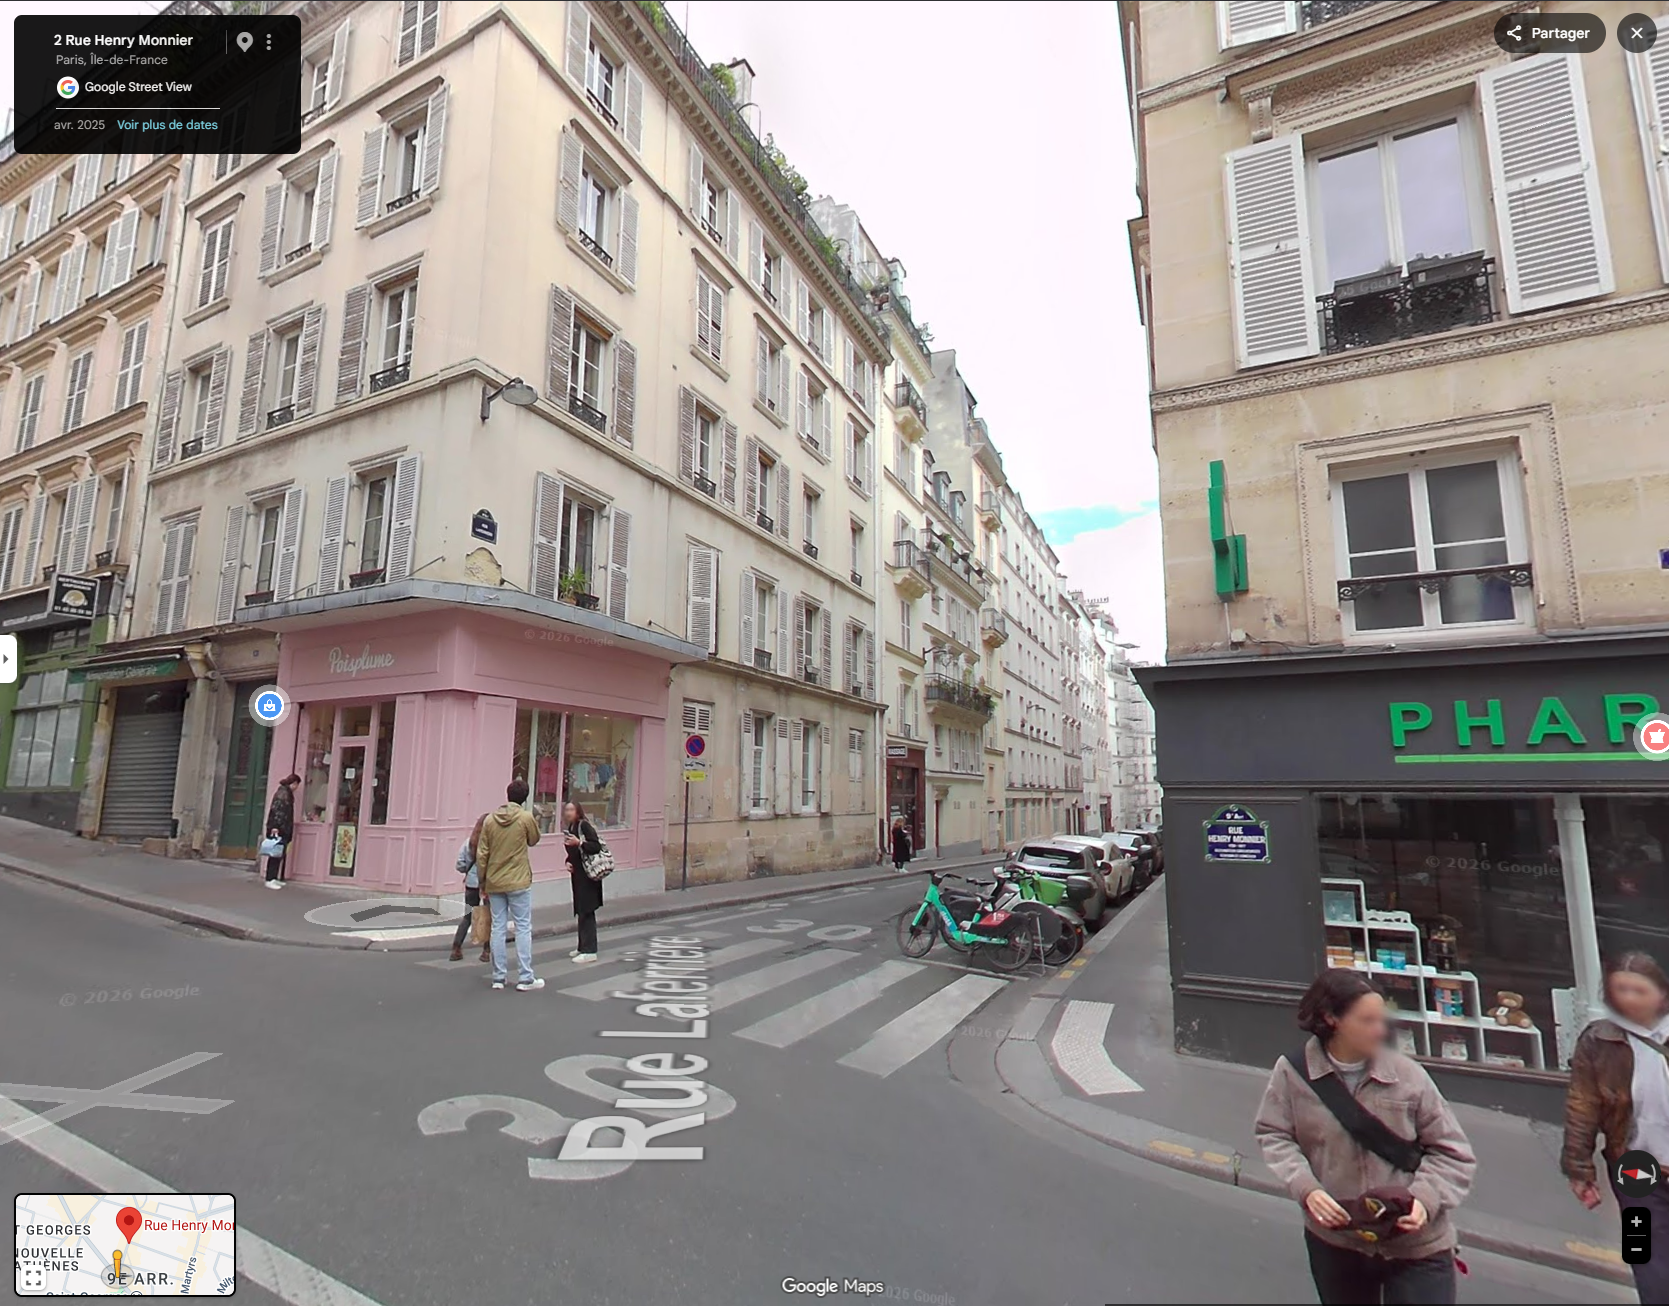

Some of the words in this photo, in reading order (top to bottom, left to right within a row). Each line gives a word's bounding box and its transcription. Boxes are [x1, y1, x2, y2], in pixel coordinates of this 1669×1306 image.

[328, 643, 395, 678] Poisplume
[1388, 693, 1661, 748] PHAR
[1207, 834, 1232, 843] HENRY
[1232, 835, 1267, 844] MONNIER
[1227, 826, 1244, 835] RUE
